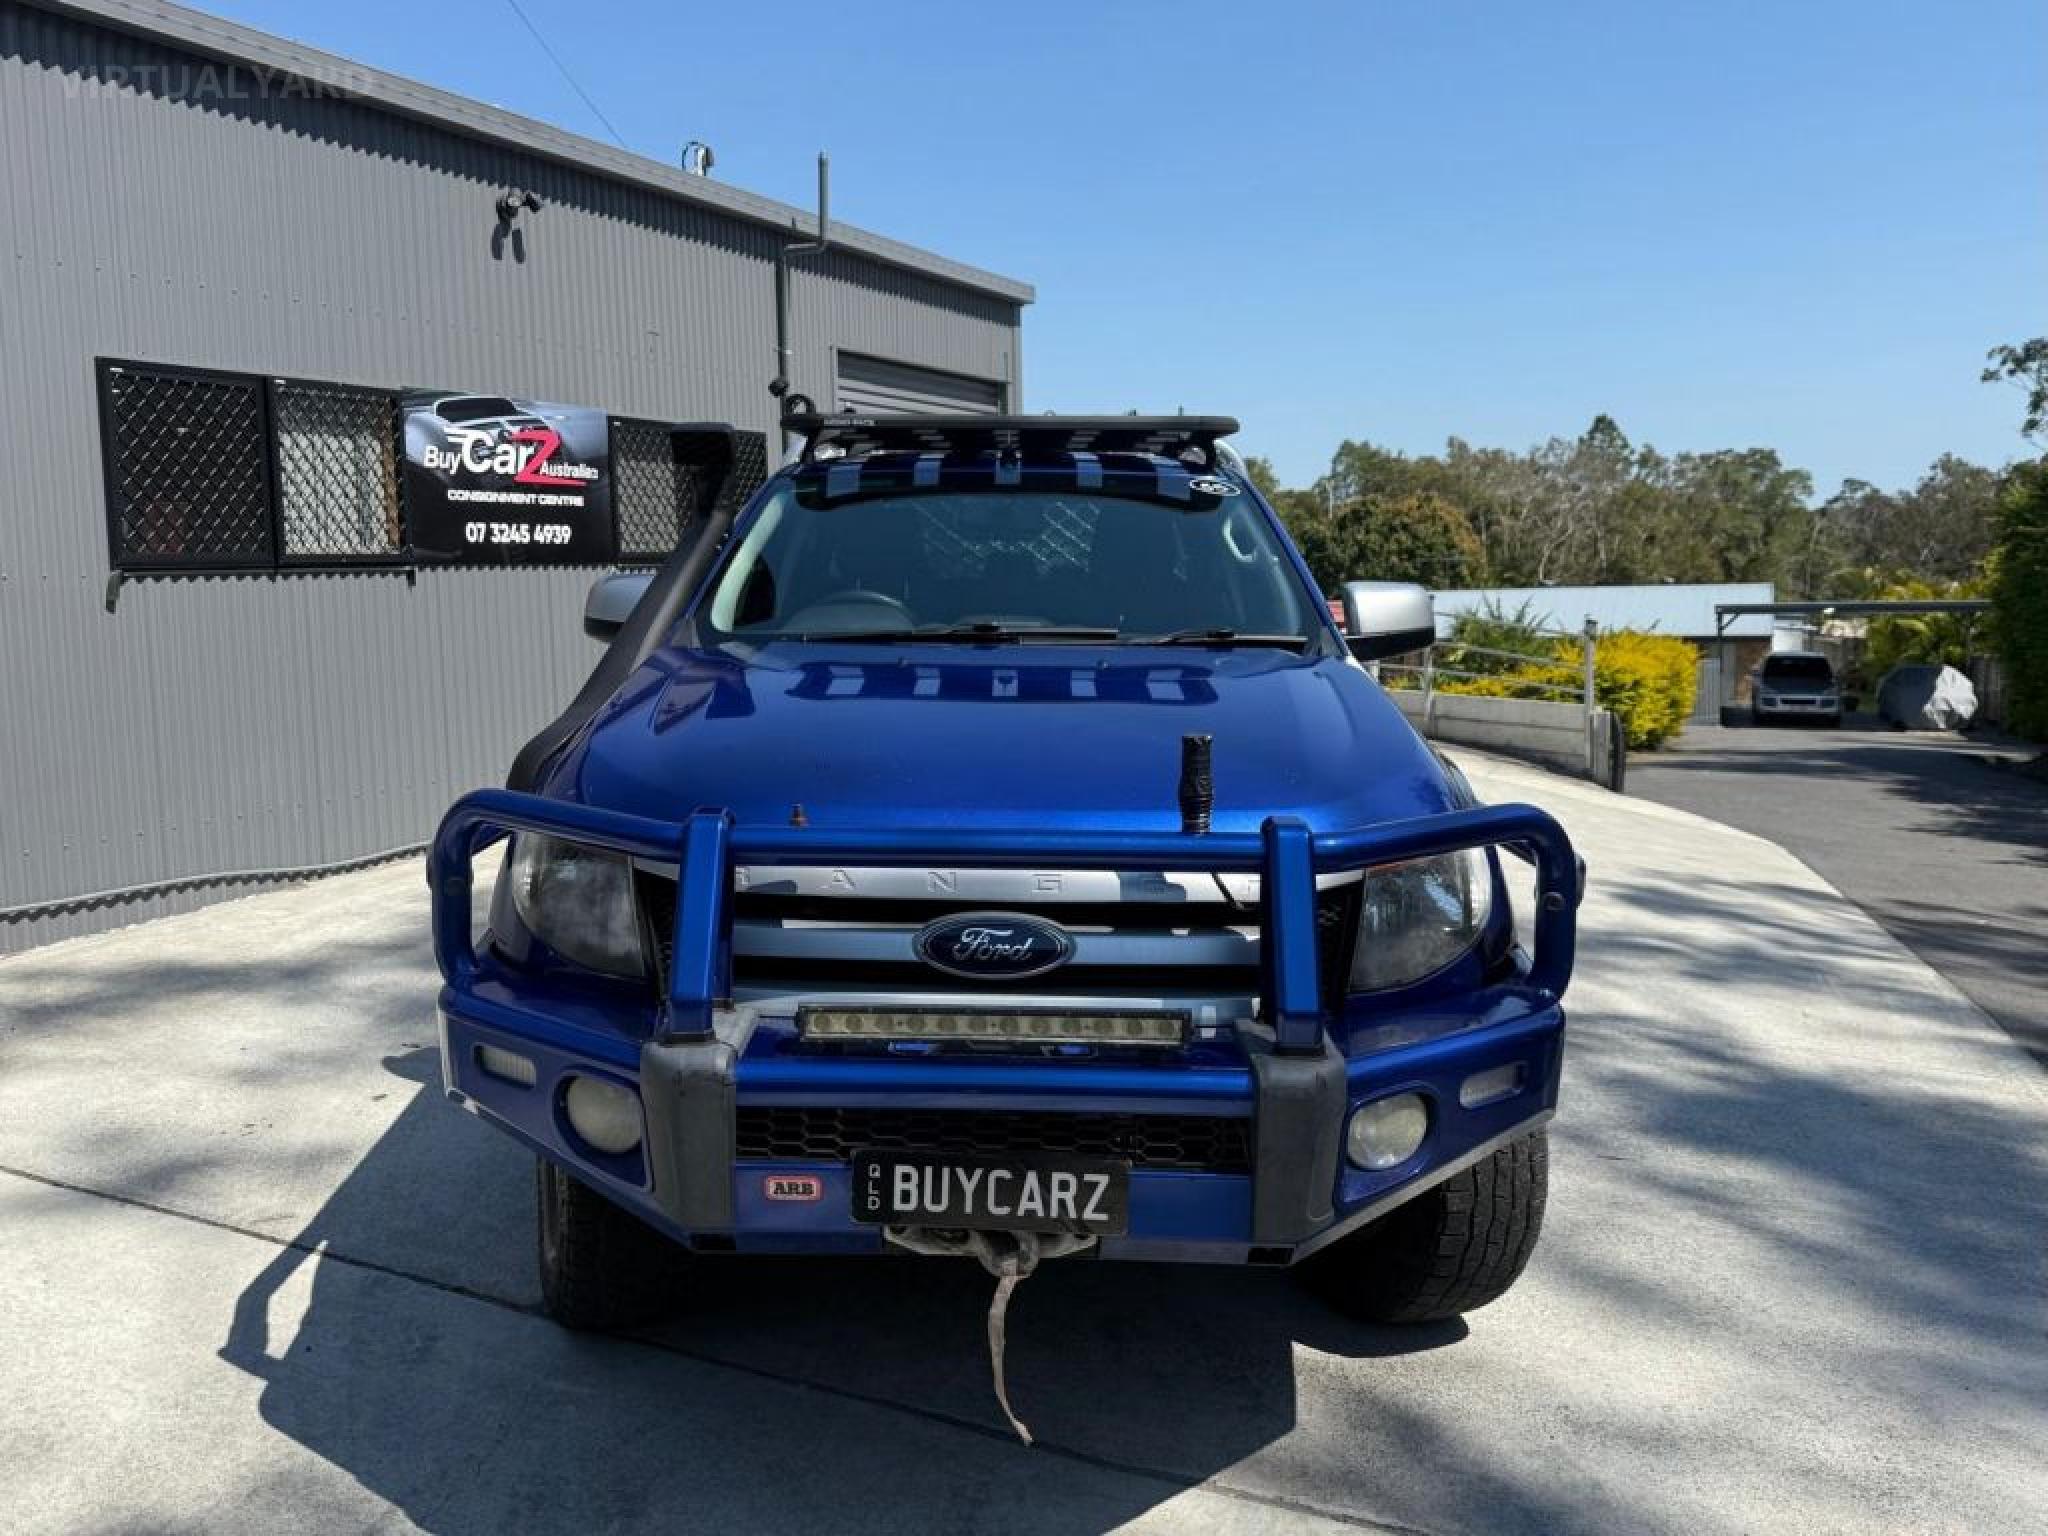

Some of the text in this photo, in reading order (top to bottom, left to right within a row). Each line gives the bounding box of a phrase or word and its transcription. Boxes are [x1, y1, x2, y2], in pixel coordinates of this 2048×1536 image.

[465, 521, 572, 544] 07 3245 4939
[952, 927, 1034, 960] Ford
[773, 1181, 815, 1195] ARB
[893, 1164, 1111, 1221] BUYCARZ
